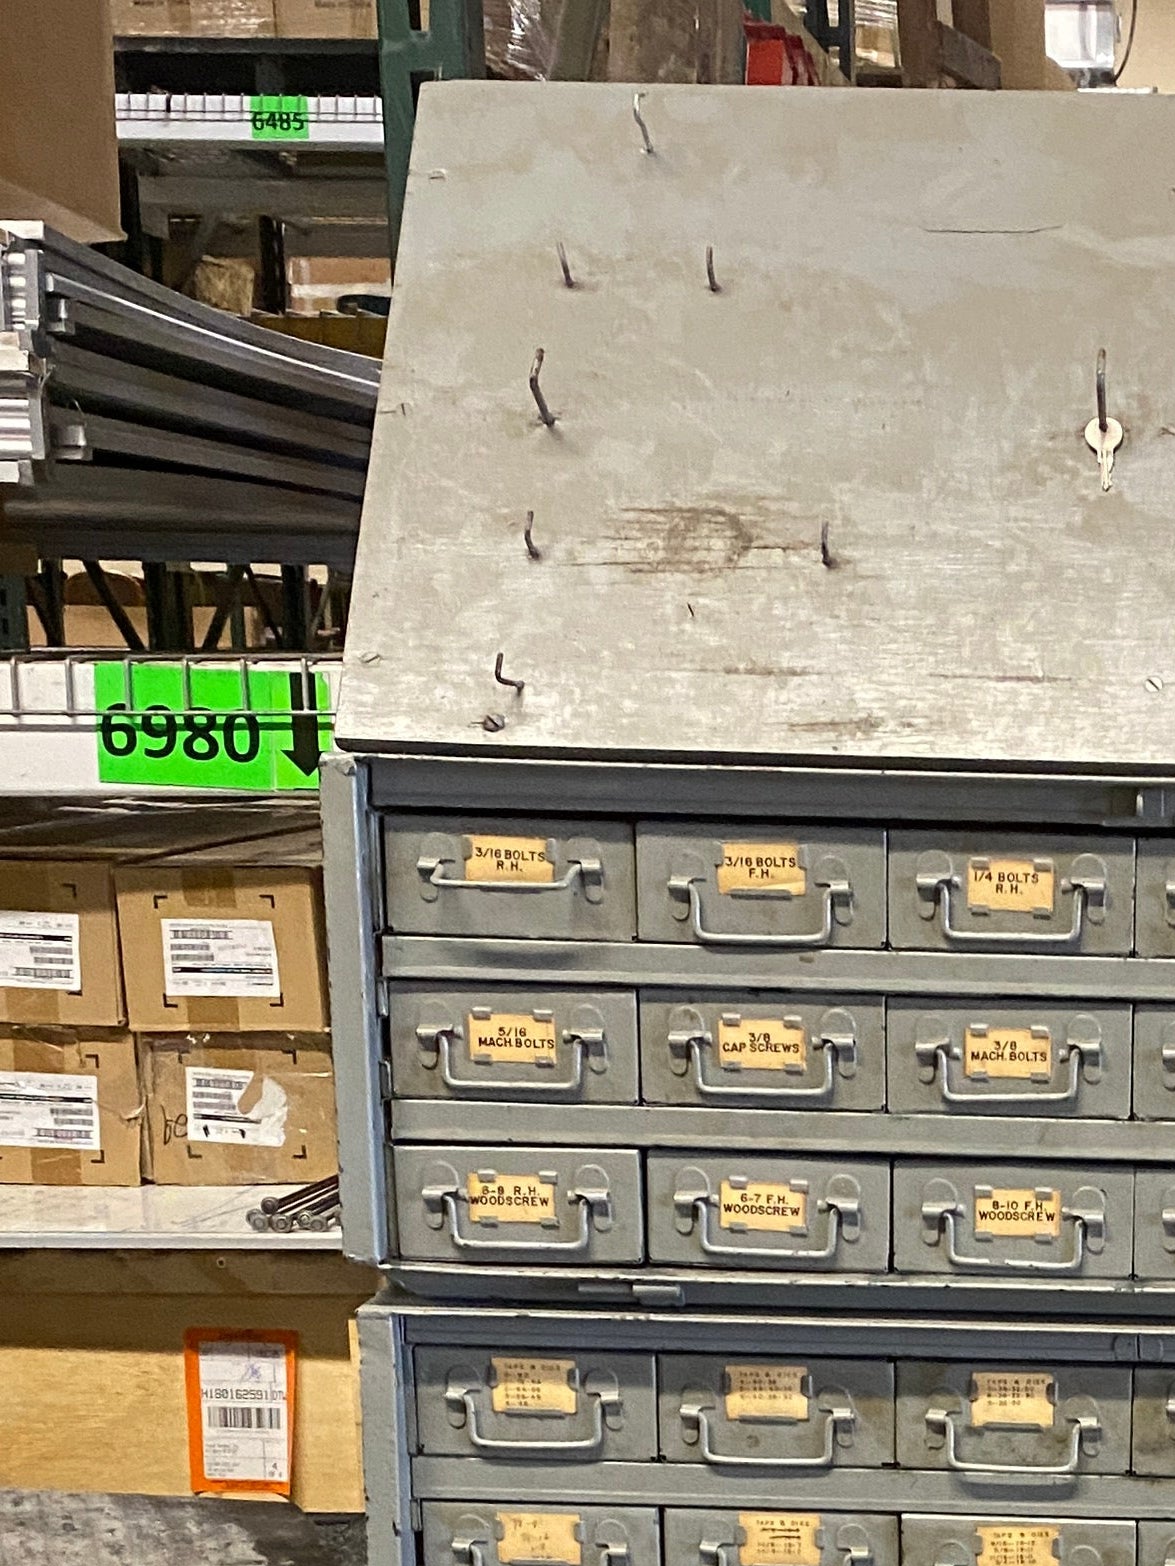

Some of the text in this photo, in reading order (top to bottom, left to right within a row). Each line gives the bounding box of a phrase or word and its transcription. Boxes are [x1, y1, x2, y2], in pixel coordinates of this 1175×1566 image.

[252, 112, 304, 131] 6485
[102, 703, 260, 763] 6980
[475, 847, 545, 862] 3/16 BOLTS
[497, 863, 523, 872] R.H.
[724, 857, 796, 868] 3/16 BOLTS
[749, 868, 774, 878] F.H.
[973, 871, 1039, 883] 1/4 BOLTS
[995, 883, 1023, 894] R.H.
[498, 1027, 527, 1037] 5/16
[748, 1032, 770, 1042] 3/8
[723, 1042, 800, 1053] CAP SCREWS
[994, 1041, 1017, 1051] 3/8
[513, 1186, 540, 1196] R.H.
[469, 1195, 549, 1207] WOODSCREW
[766, 1194, 788, 1204] F.H.
[723, 1203, 800, 1216] WOODSCREW
[992, 1201, 1047, 1211] 8-10 F.H.
[979, 1211, 1055, 1222] WOODSCREW
